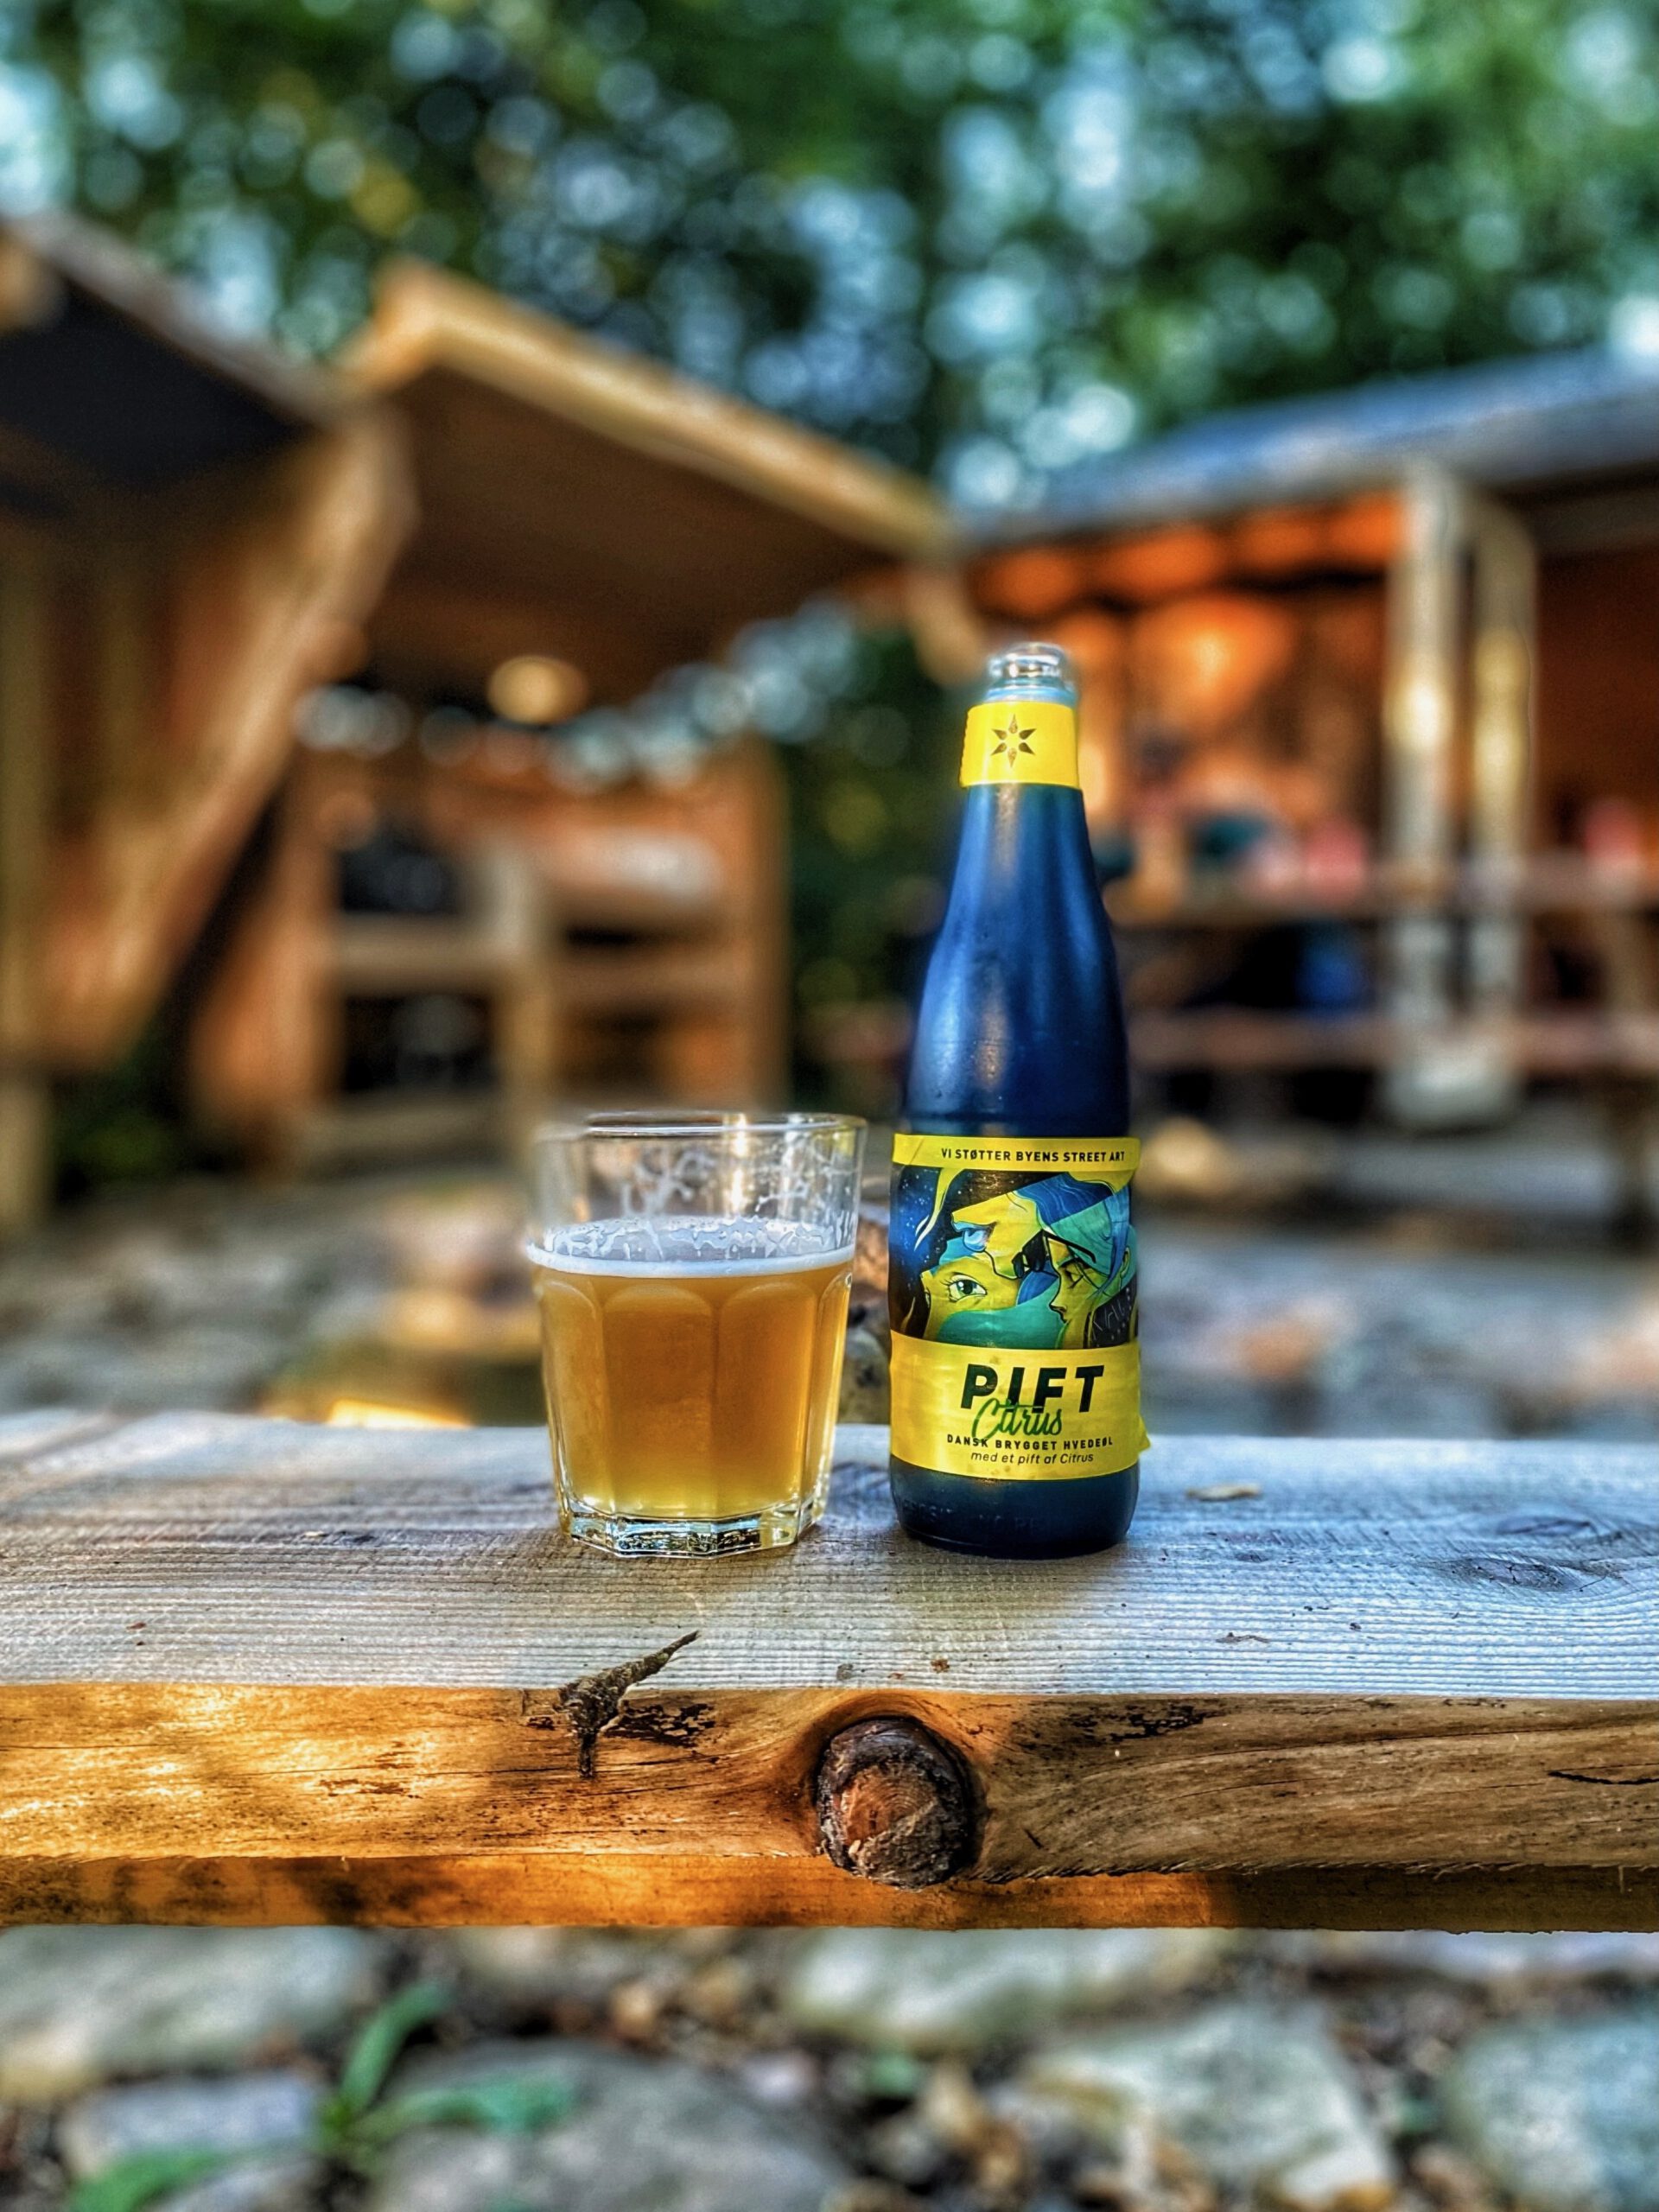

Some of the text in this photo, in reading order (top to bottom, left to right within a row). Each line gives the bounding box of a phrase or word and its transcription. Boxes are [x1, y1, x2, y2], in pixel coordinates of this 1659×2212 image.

[941, 1148, 1126, 1162] VI STØTTER BYENS STREET ART
[961, 1363, 1104, 1413] PIFT
[972, 1398, 1062, 1443] Citrus
[947, 1433, 1113, 1451] DANSK BRYGGET HVEDEØL
[970, 1451, 1094, 1465] med et pift af Citrus
